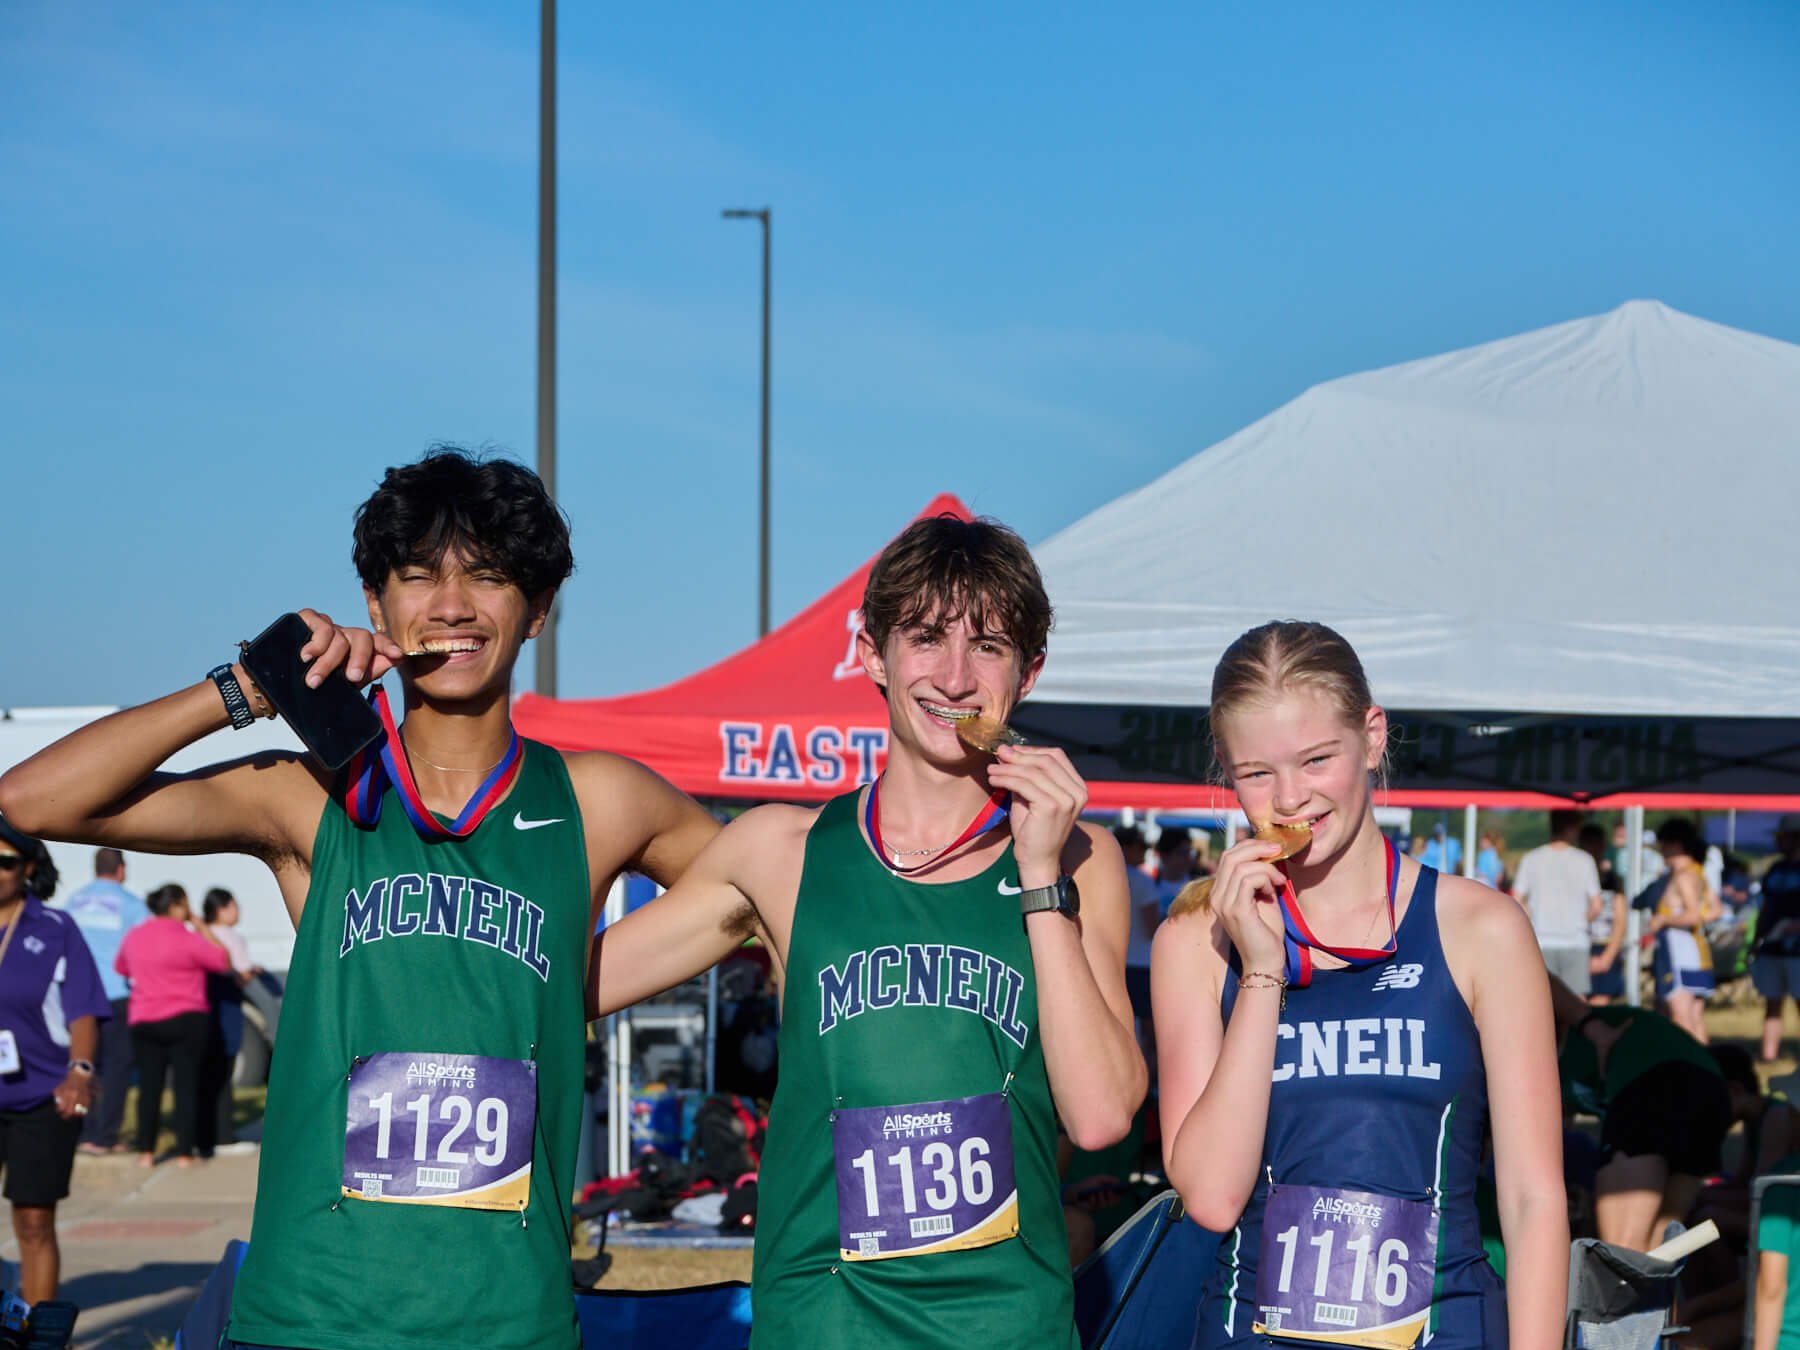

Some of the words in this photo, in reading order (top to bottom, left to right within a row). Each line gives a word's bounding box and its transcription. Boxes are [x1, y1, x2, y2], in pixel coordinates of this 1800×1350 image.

[718, 720, 889, 786] EAST
[340, 873, 550, 983] MCNEIL
[818, 944, 1028, 1049] MCNEIL
[406, 1062, 476, 1080] AllSports
[1272, 1018, 1441, 1082] CNEIL
[407, 1077, 475, 1089] TIMING
[369, 1092, 509, 1167] 1129
[883, 1112, 952, 1129] AllSports
[883, 1126, 953, 1140] TIMING
[852, 1137, 994, 1217] 1136
[1313, 1197, 1382, 1217] AllSports
[1313, 1212, 1379, 1228] TIMING
[1276, 1226, 1409, 1307] 1116
